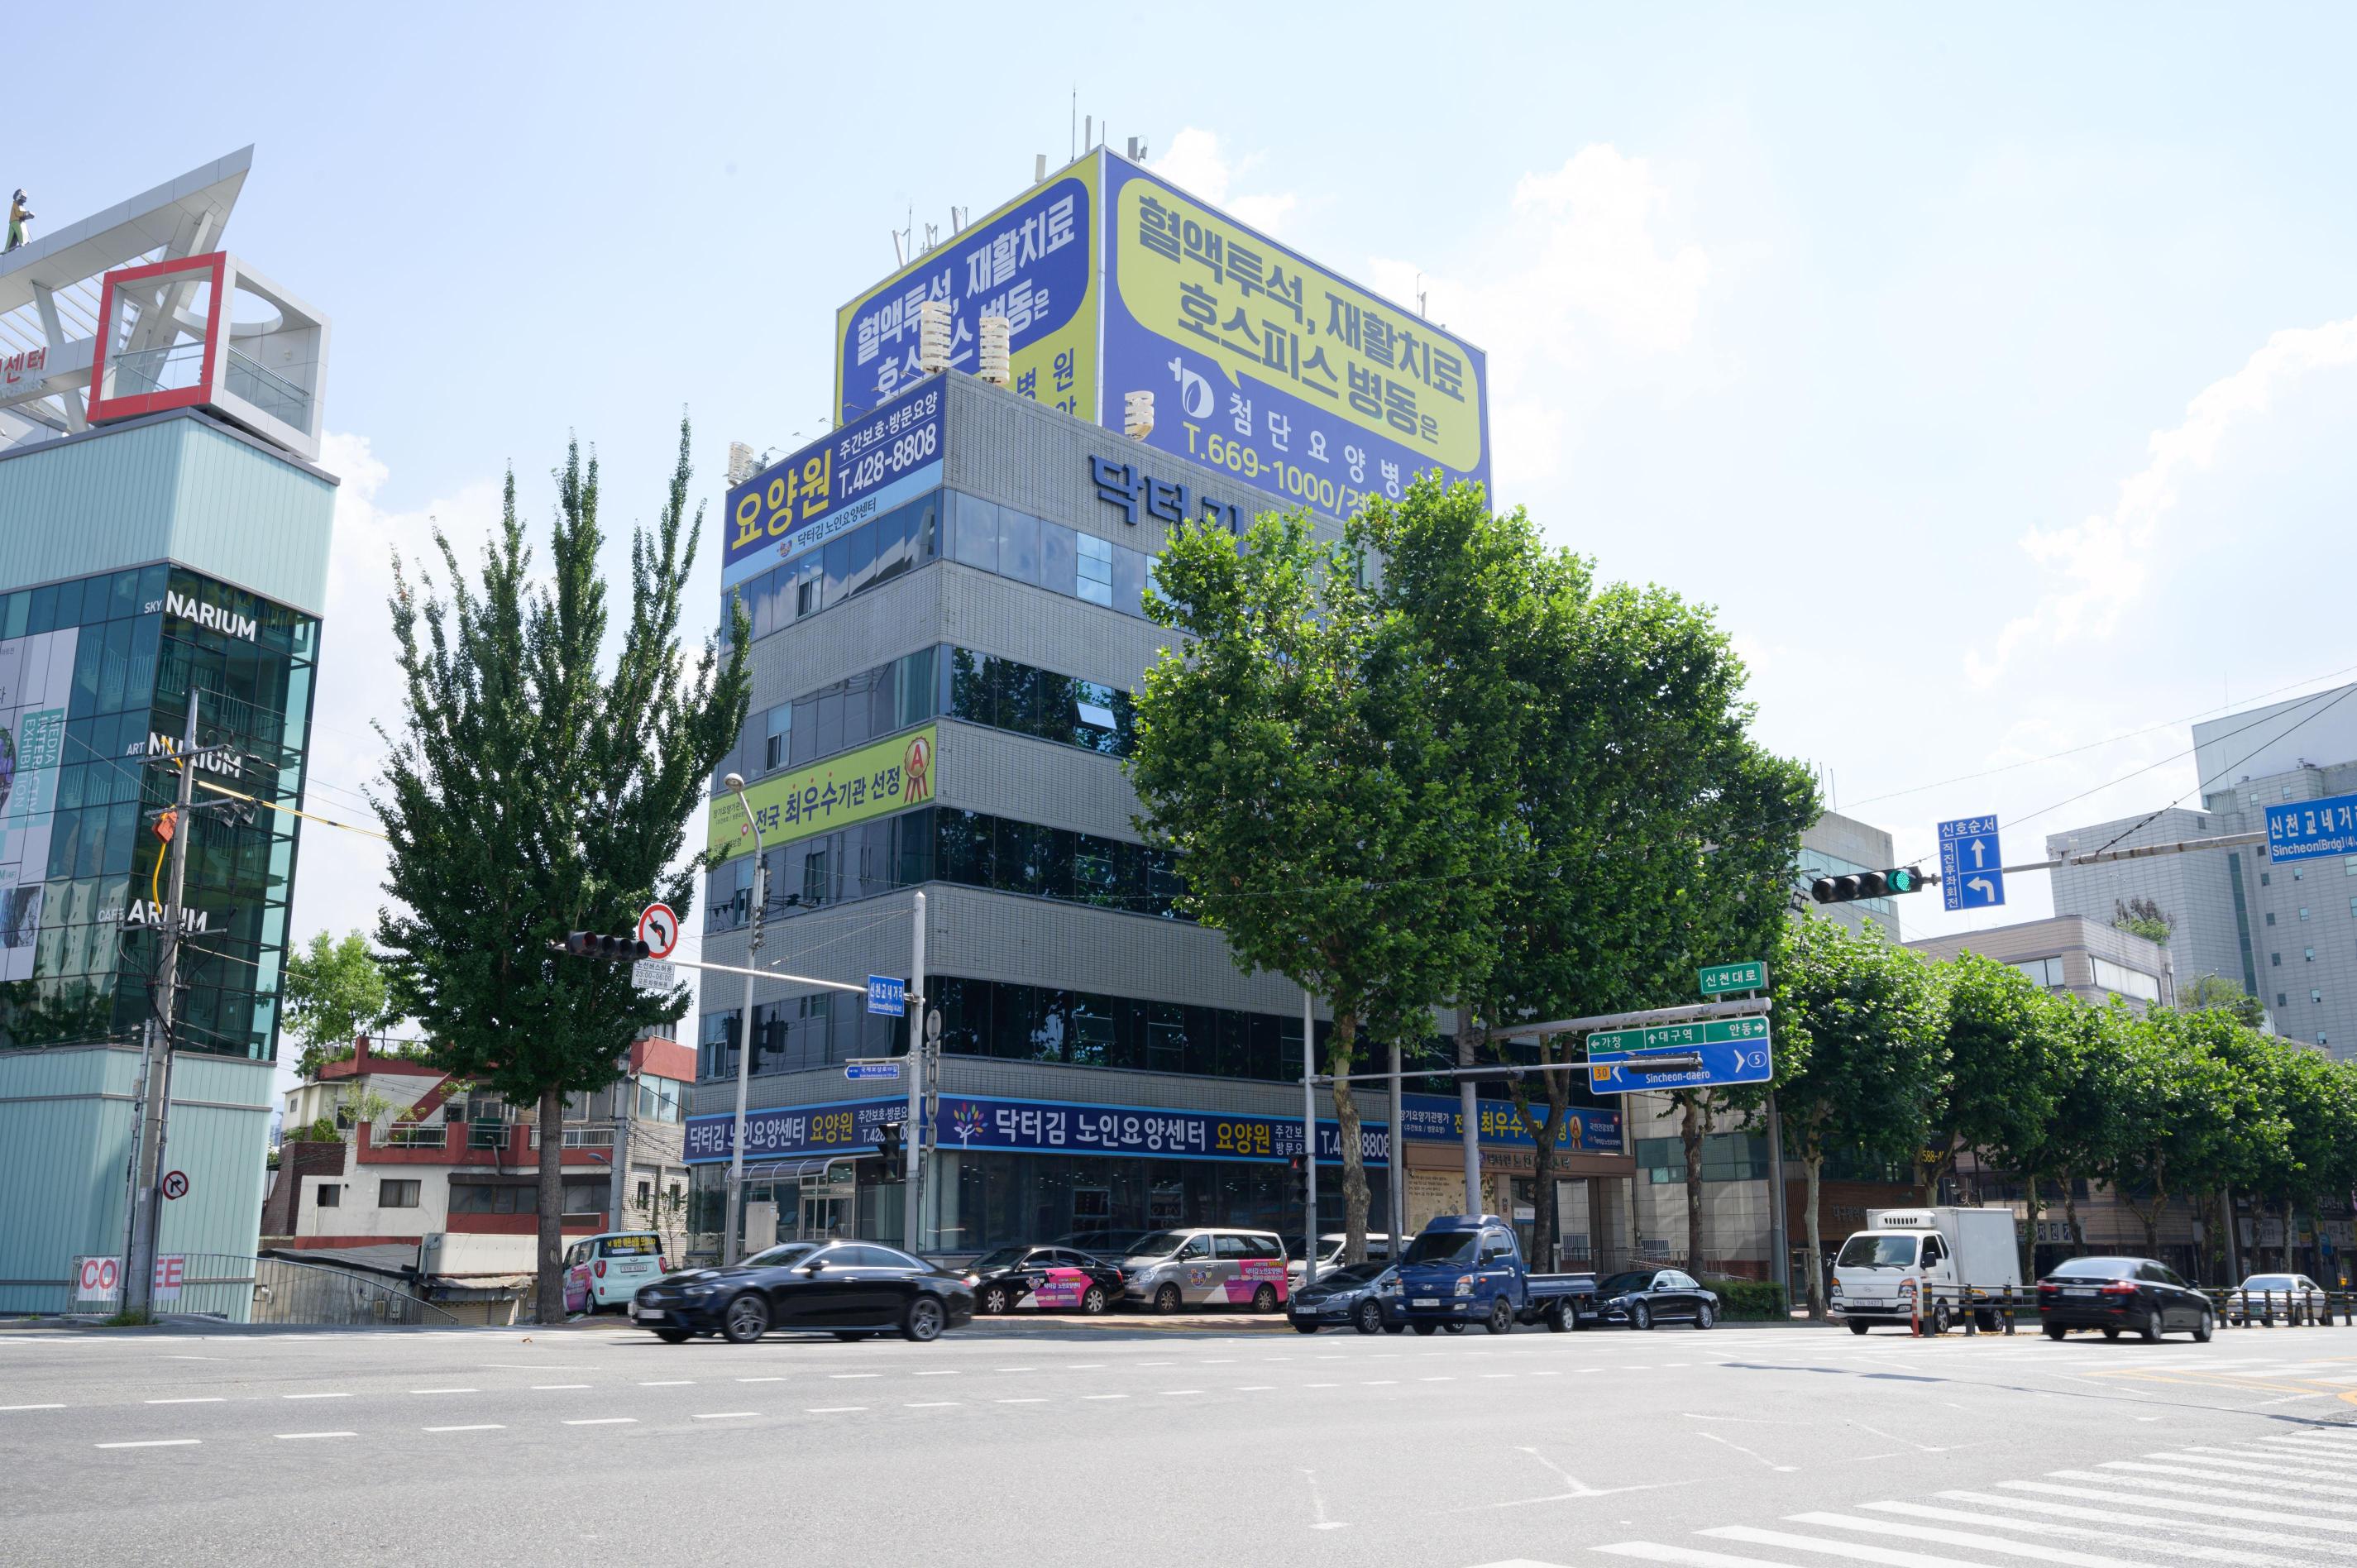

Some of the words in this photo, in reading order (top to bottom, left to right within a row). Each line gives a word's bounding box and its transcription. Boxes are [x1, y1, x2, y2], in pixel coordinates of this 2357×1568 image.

[966, 194, 1074, 299] 재활치료
[1140, 194, 1315, 335] 혈액투석,
[1325, 291, 1465, 403] 재활치료
[0, 347, 46, 384] 센터
[877, 318, 973, 407] 호스스
[1178, 282, 1339, 399] 호스피스
[1348, 361, 1439, 446] 병동은
[839, 423, 936, 499] T.428-8808
[732, 448, 832, 551] 요양원
[797, 524, 824, 547] 닥터김
[825, 497, 877, 533] 노인요양센터
[145, 600, 163, 614] SKY
[166, 590, 256, 643] NARIUM
[45, 715, 61, 765] MEDIA
[126, 742, 146, 756] ART
[911, 744, 924, 771] A
[14, 718, 36, 808] EXHIBITION
[24, 716, 49, 823] INTERACTIVE
[756, 805, 780, 834] 전국
[785, 777, 866, 825] 최우수기관
[871, 765, 901, 801] 선정
[1942, 817, 1995, 838] 신호순서
[2271, 806, 2357, 840] 신천교네거
[98, 908, 124, 922] CAFE
[1705, 969, 1757, 987] 신천대로
[1601, 1035, 1622, 1049] 가창
[1659, 1028, 1692, 1043] 대구역
[1729, 1023, 1752, 1037] 안동
[1596, 1068, 1607, 1078] 30
[1754, 1054, 1761, 1064] 5
[1646, 1071, 1710, 1084] Sincheon-daero
[690, 1121, 725, 1153] 닥터김
[810, 1112, 853, 1143] 요양원
[996, 1109, 1066, 1145] 닥터김
[1076, 1114, 1205, 1152] 노인요양센터
[1216, 1122, 1270, 1154] 요양원
[1572, 1118, 1580, 1135] A
[1590, 1123, 1615, 1132] 국민건강보험
[81, 1259, 184, 1289] COEE
